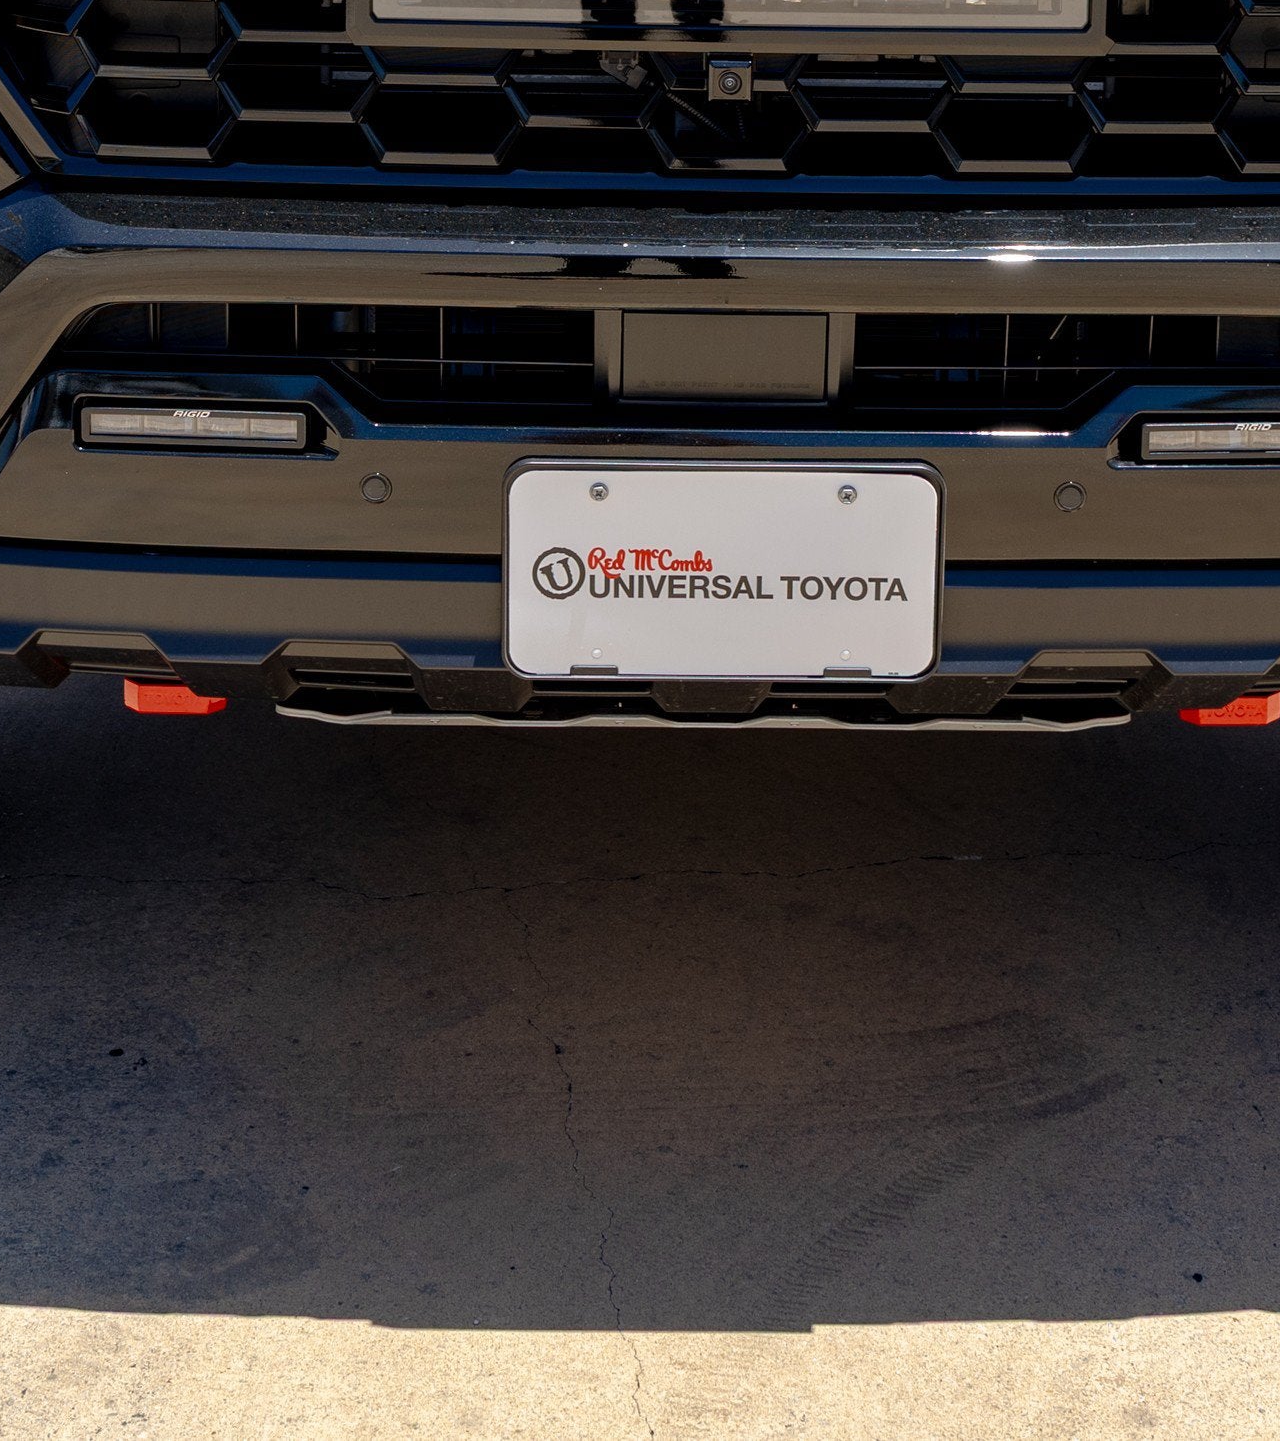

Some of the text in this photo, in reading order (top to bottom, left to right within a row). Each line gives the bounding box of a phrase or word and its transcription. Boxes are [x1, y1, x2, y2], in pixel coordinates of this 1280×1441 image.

[173, 409, 211, 418] RIGID
[587, 546, 714, 579] Red McCombs
[588, 574, 774, 600] UNIVERSAL
[780, 575, 909, 602] TOYOTA
